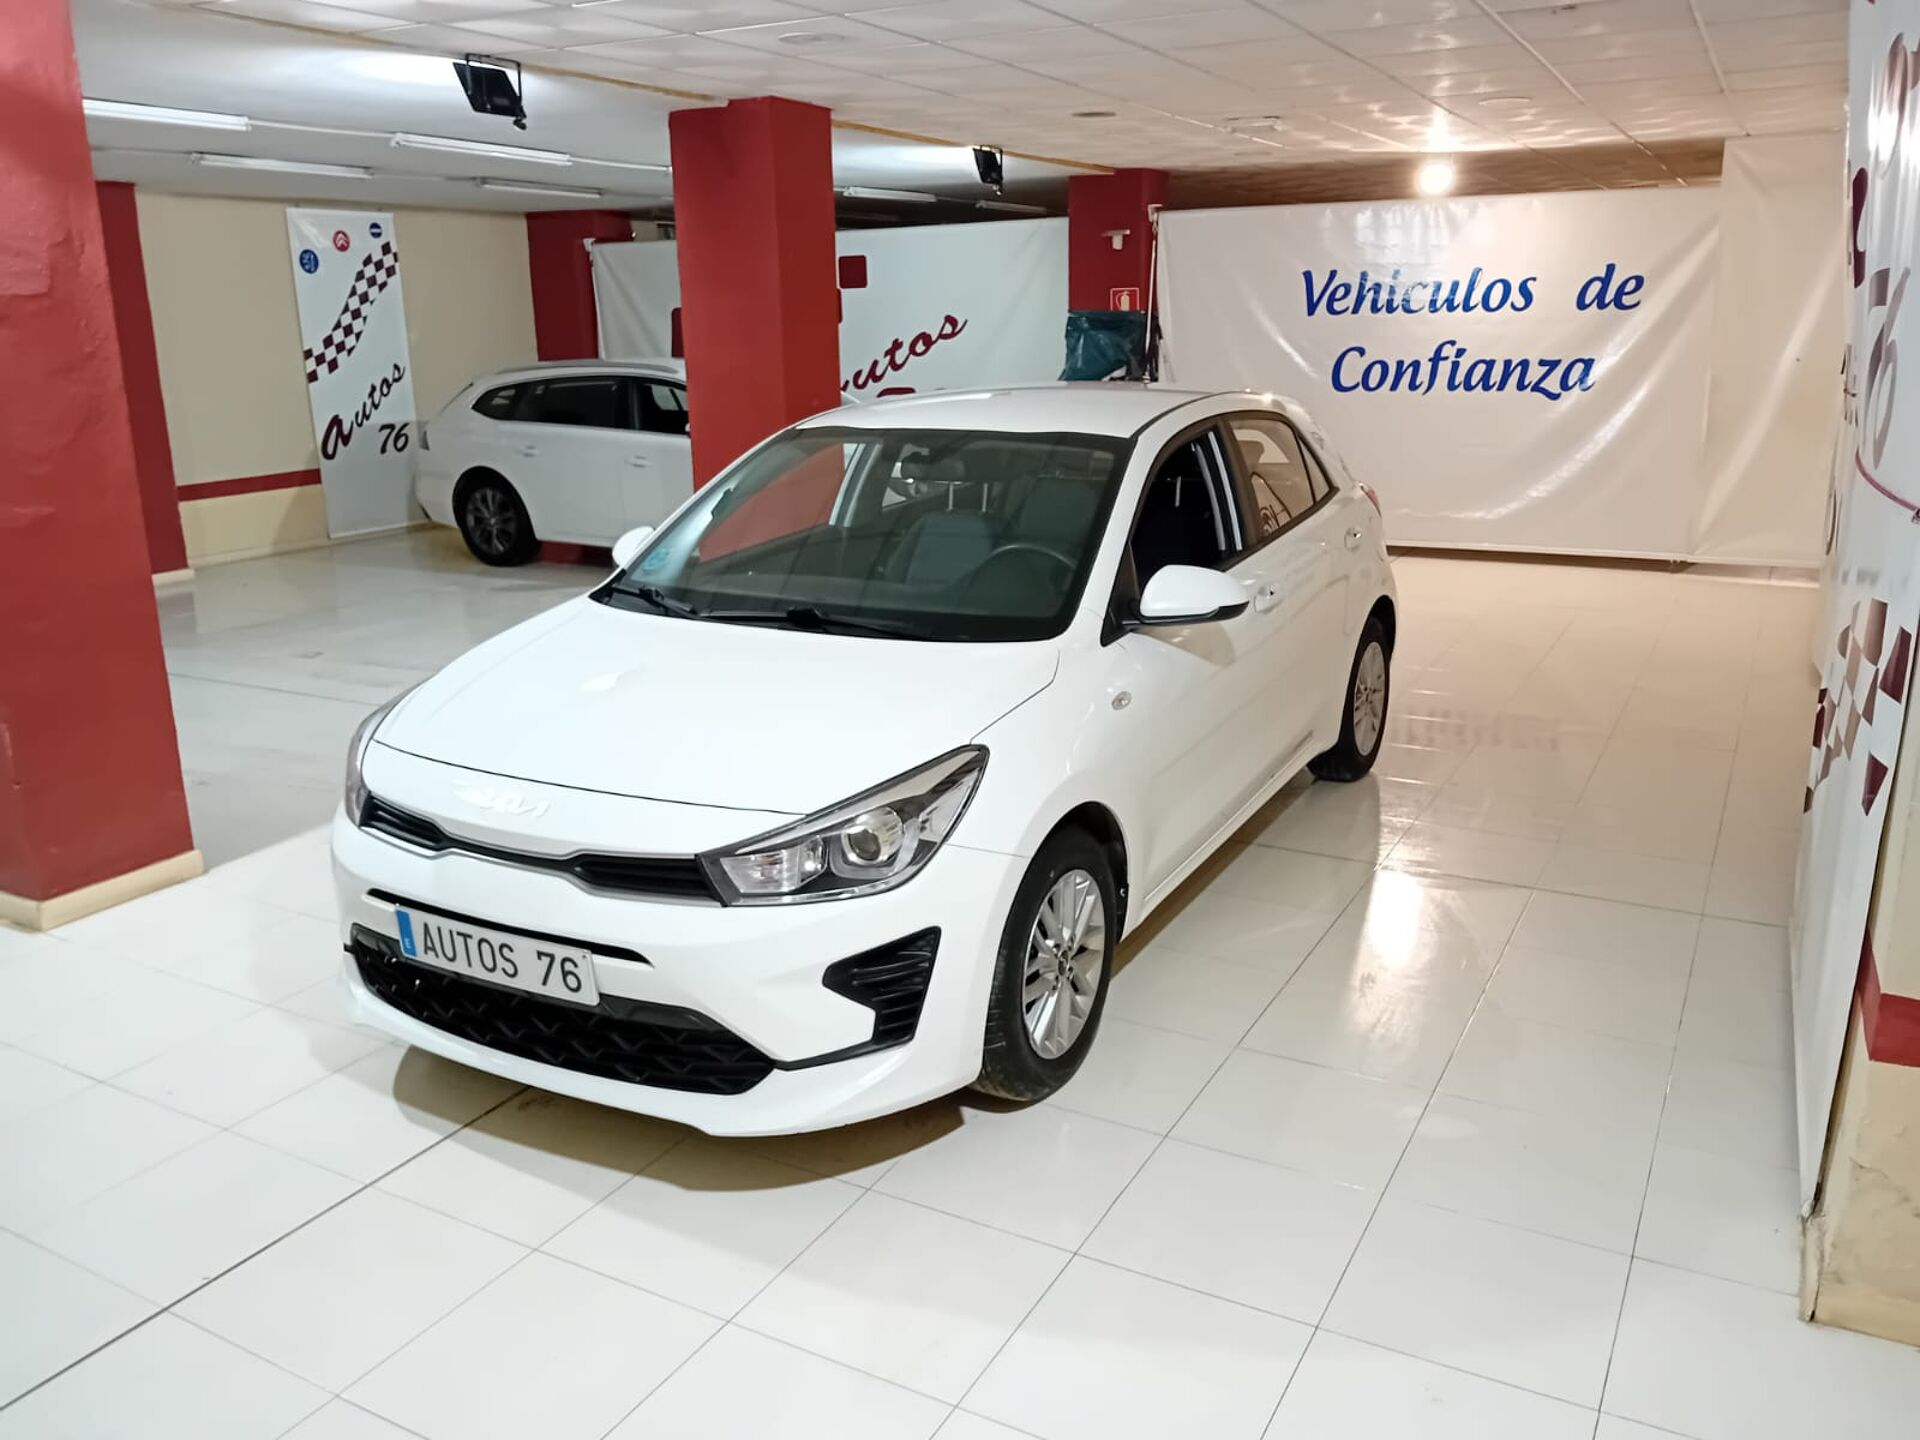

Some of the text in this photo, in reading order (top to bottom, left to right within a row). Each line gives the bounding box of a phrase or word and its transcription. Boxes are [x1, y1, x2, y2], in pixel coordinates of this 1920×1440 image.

[1576, 263, 1645, 311] de
[840, 314, 968, 393] utos
[1331, 339, 1596, 401] Confianza
[378, 421, 410, 455] 76
[422, 921, 583, 993] AUTOS 76
